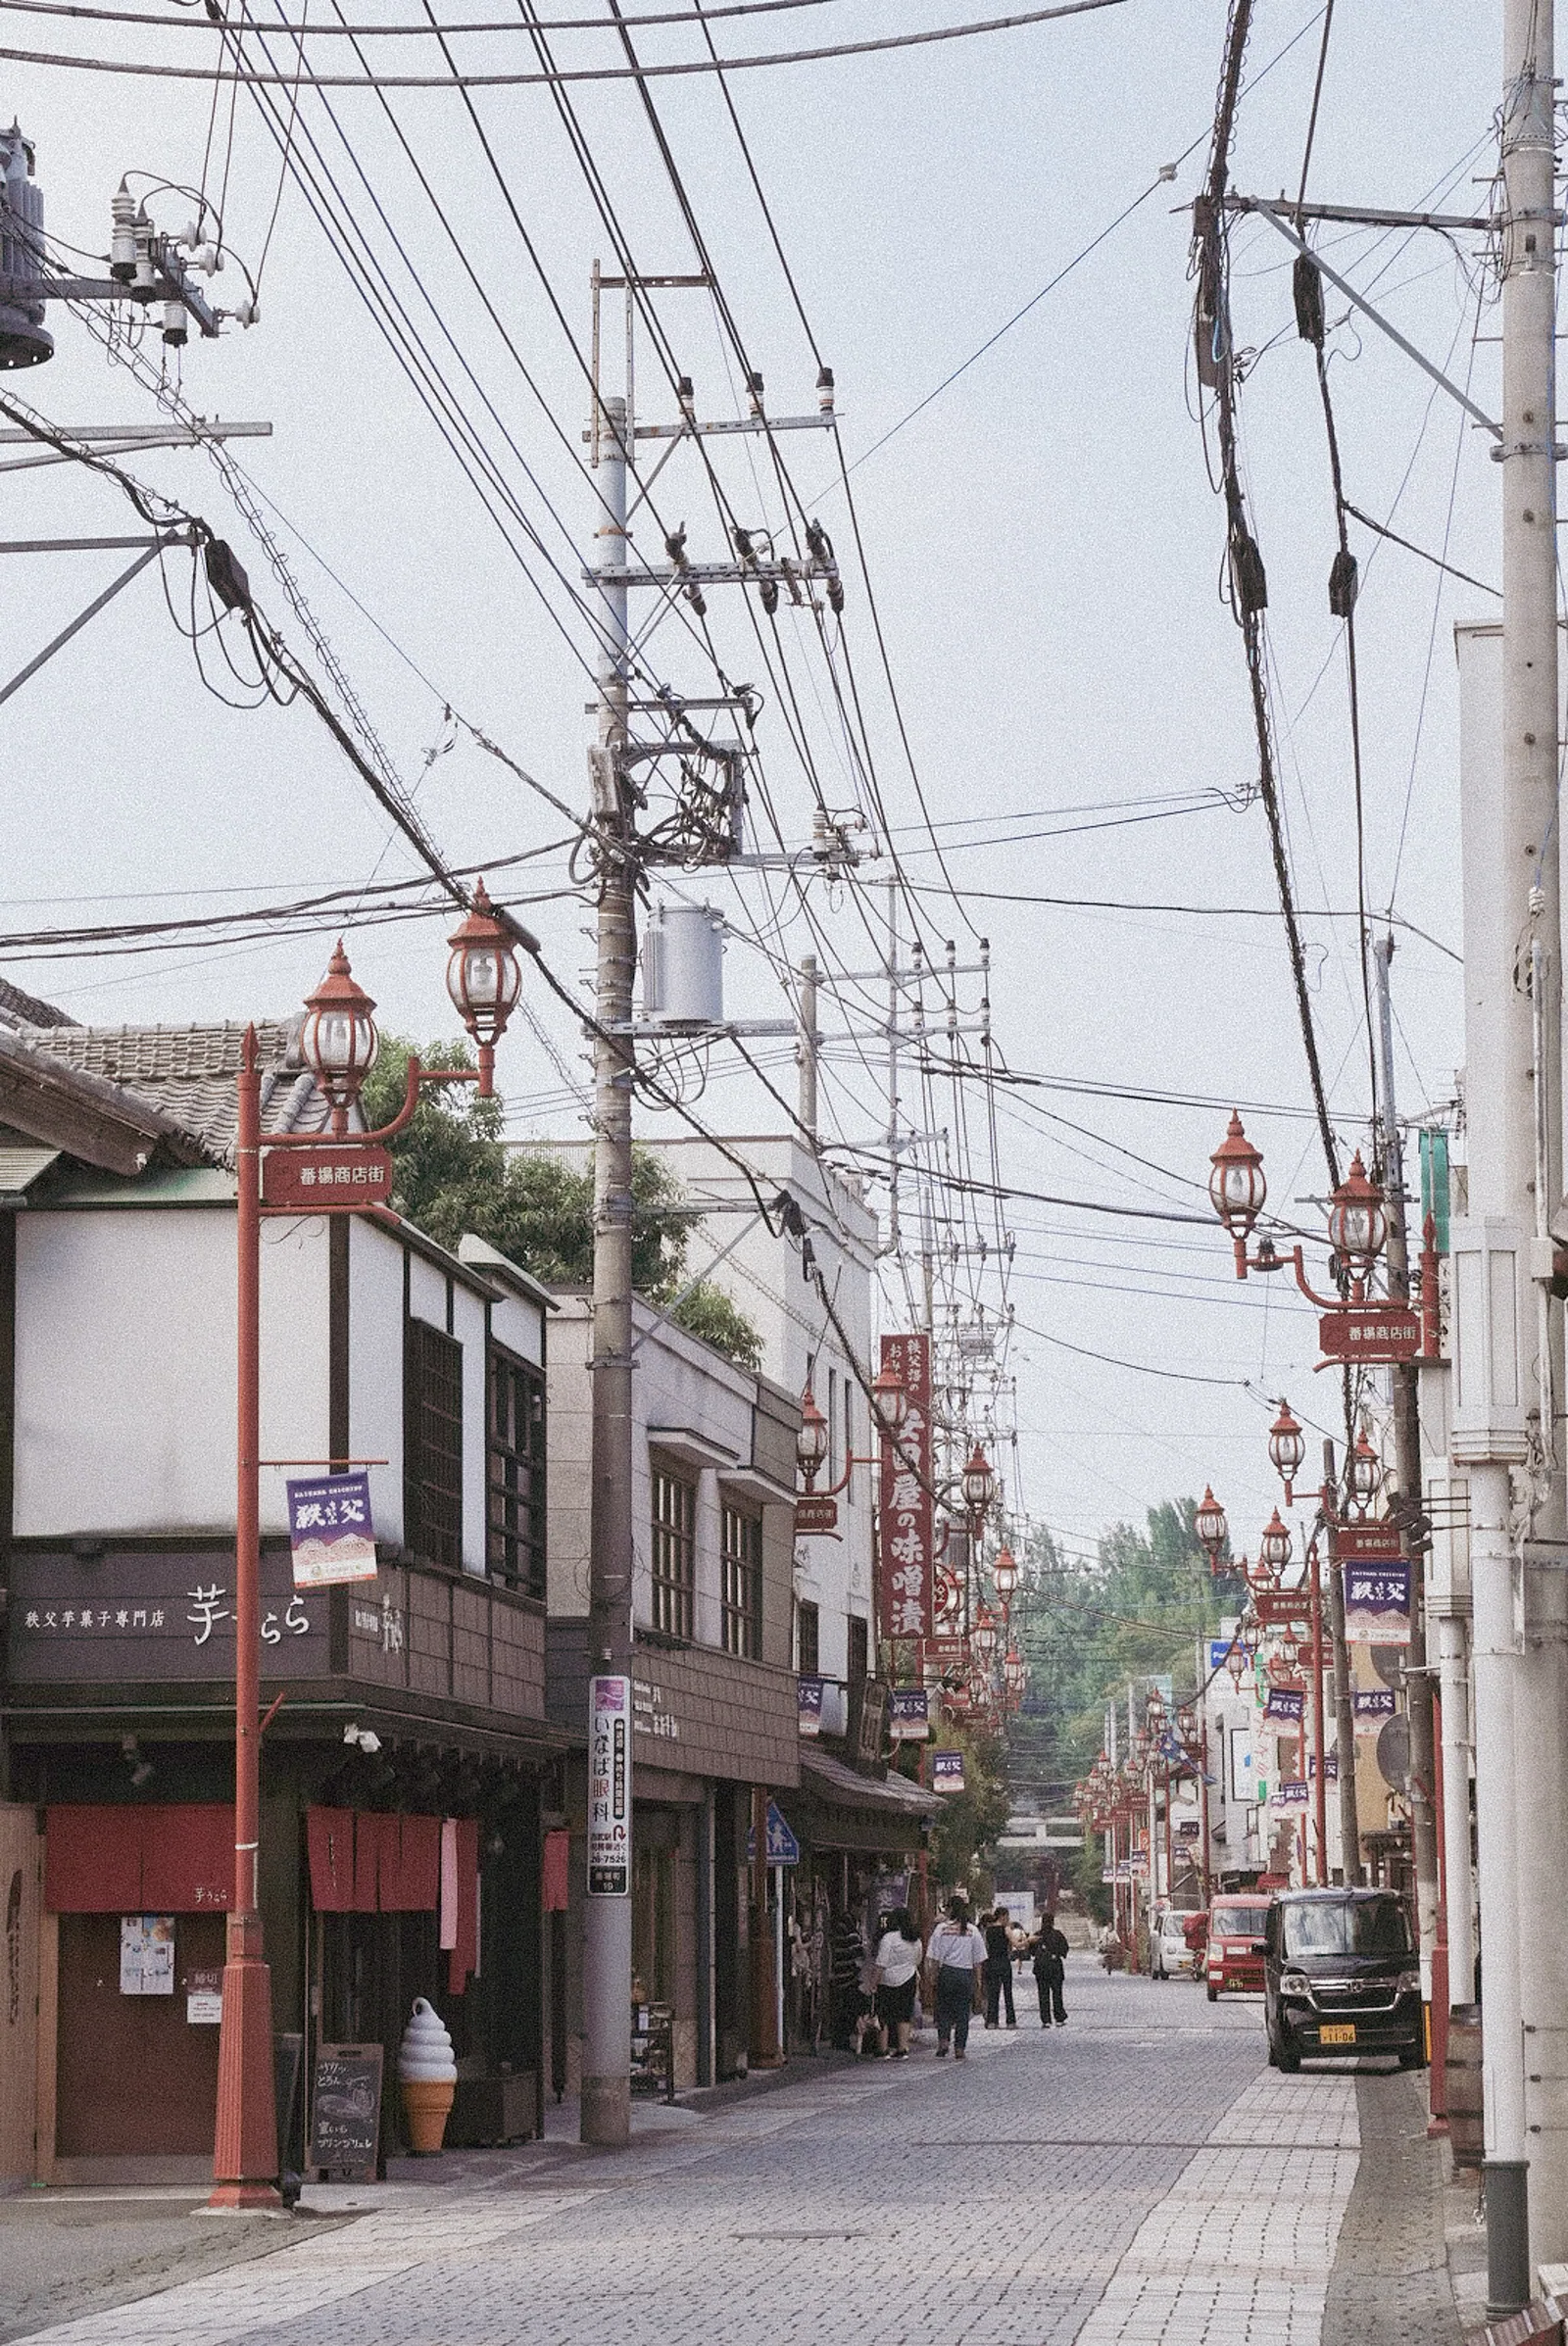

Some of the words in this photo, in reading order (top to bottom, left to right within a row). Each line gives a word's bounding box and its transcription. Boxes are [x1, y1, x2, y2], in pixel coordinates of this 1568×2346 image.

[301, 1166, 384, 1186] 番場商店街
[1348, 1326, 1416, 1341] 番場商店街
[24, 1609, 166, 1629] 秩父芋菓子専門店
[186, 1584, 311, 1645] 芋らら
[592, 1717, 612, 1823] いなば眼科
